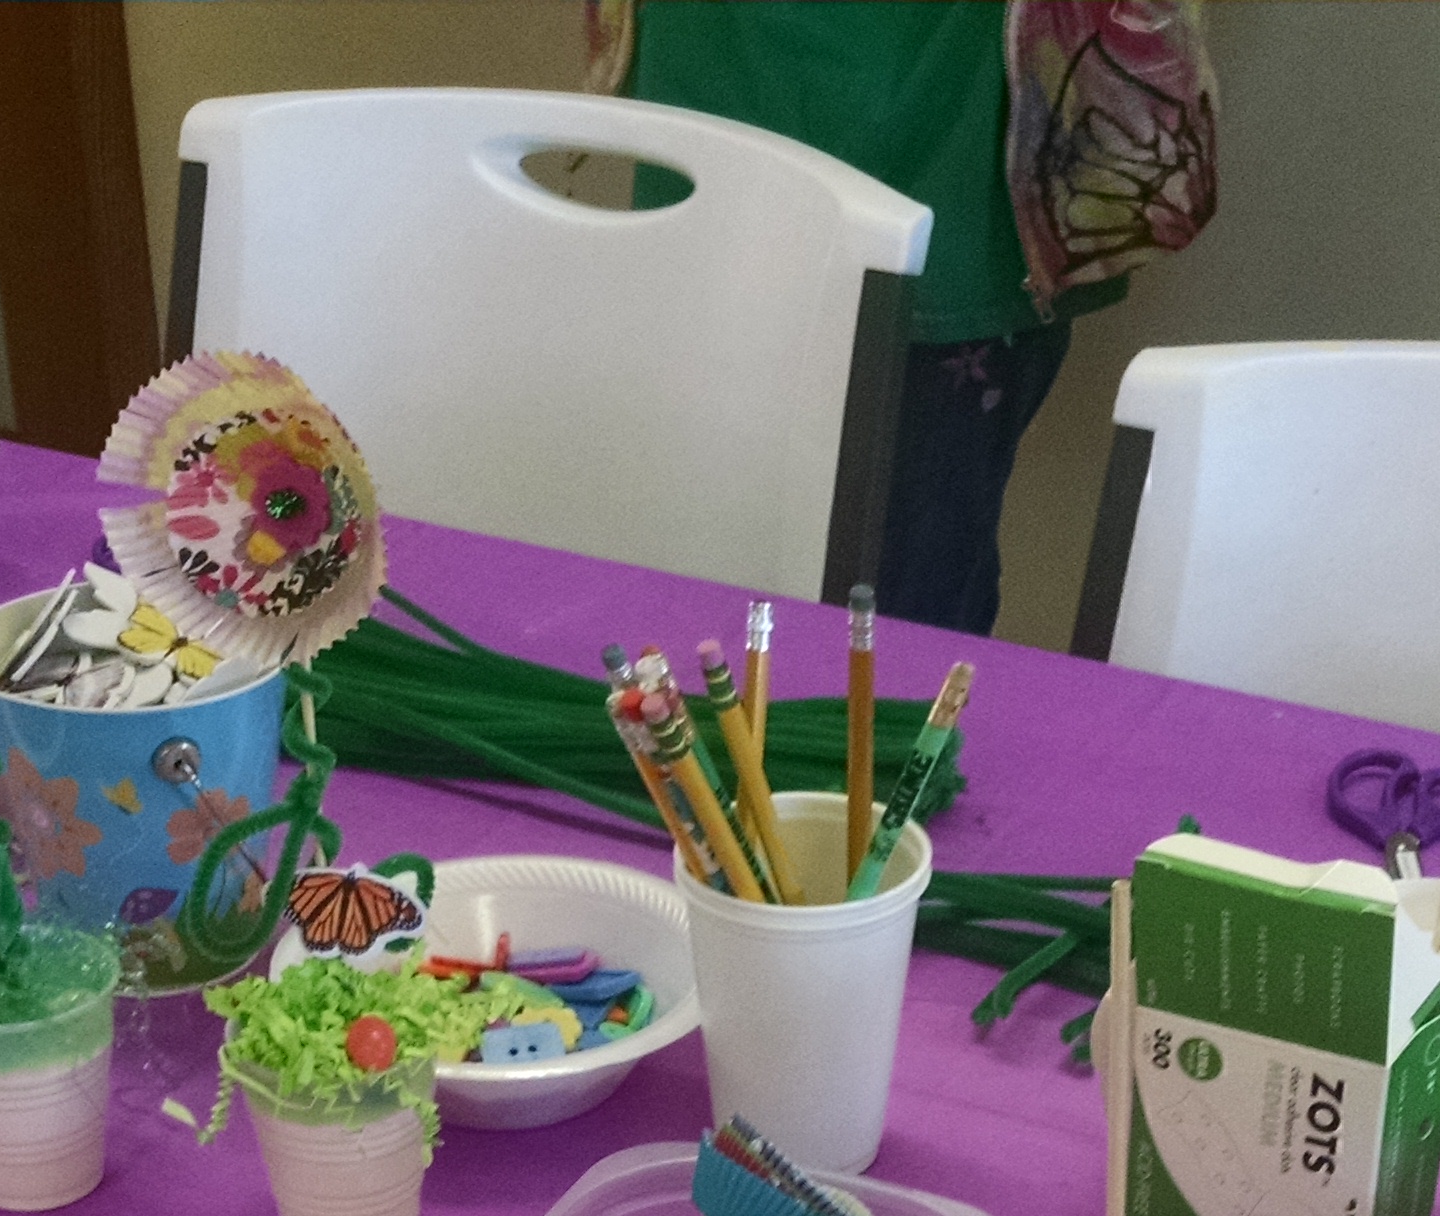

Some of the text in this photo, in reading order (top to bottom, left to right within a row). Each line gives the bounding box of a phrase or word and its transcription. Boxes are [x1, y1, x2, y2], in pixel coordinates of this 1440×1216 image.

[1152, 1027, 1172, 1071] 300
[1262, 1060, 1286, 1147] MEDIUM
[1302, 1073, 1346, 1176] ZOTS
